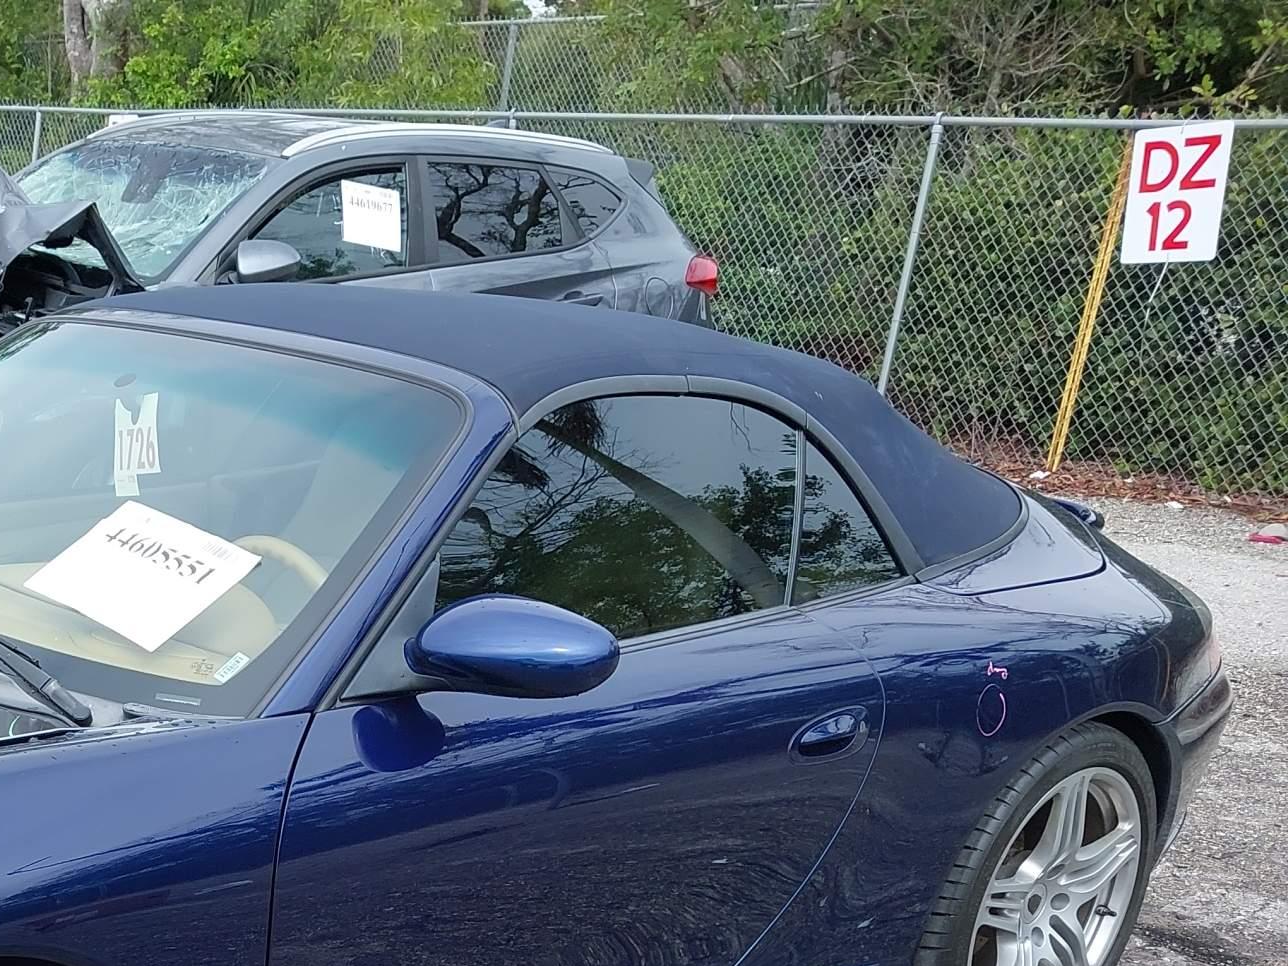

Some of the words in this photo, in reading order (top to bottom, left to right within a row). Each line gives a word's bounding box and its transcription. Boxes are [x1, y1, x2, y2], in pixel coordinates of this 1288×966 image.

[1139, 134, 1223, 194] DZ
[1146, 199, 1193, 252] 12
[117, 426, 156, 471] 1726
[105, 527, 217, 585] 44605551
